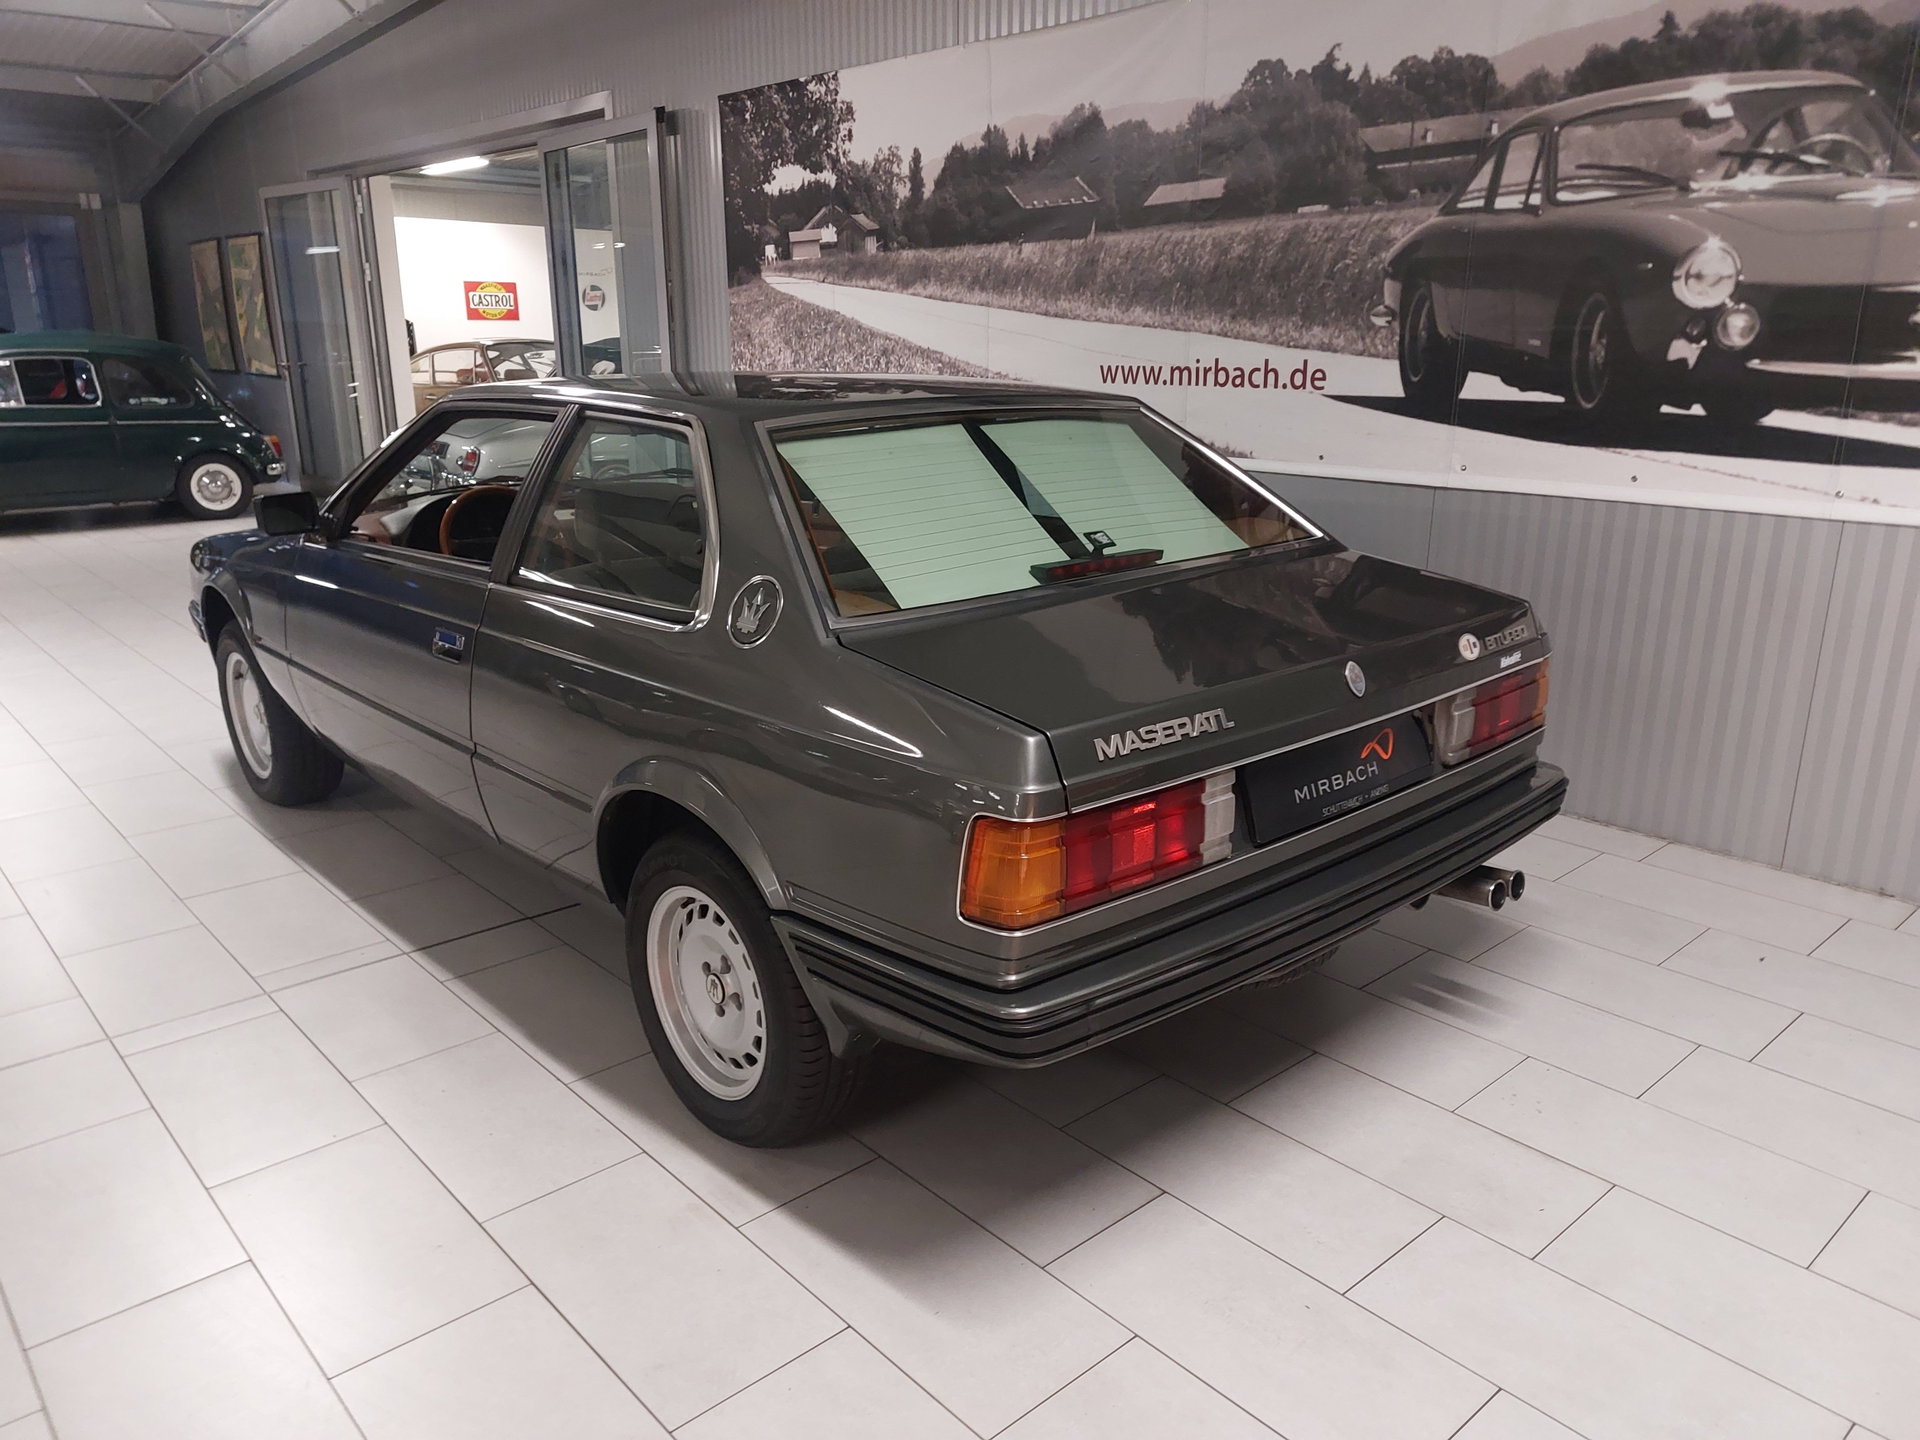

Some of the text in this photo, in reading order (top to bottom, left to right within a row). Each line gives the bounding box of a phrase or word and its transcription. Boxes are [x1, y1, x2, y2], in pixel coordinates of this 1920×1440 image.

[471, 293, 514, 307] CASTROL
[1099, 358, 1327, 391] www.mirbach.de
[1093, 707, 1236, 762] MASERATI
[1294, 761, 1379, 804] MIRBACH
